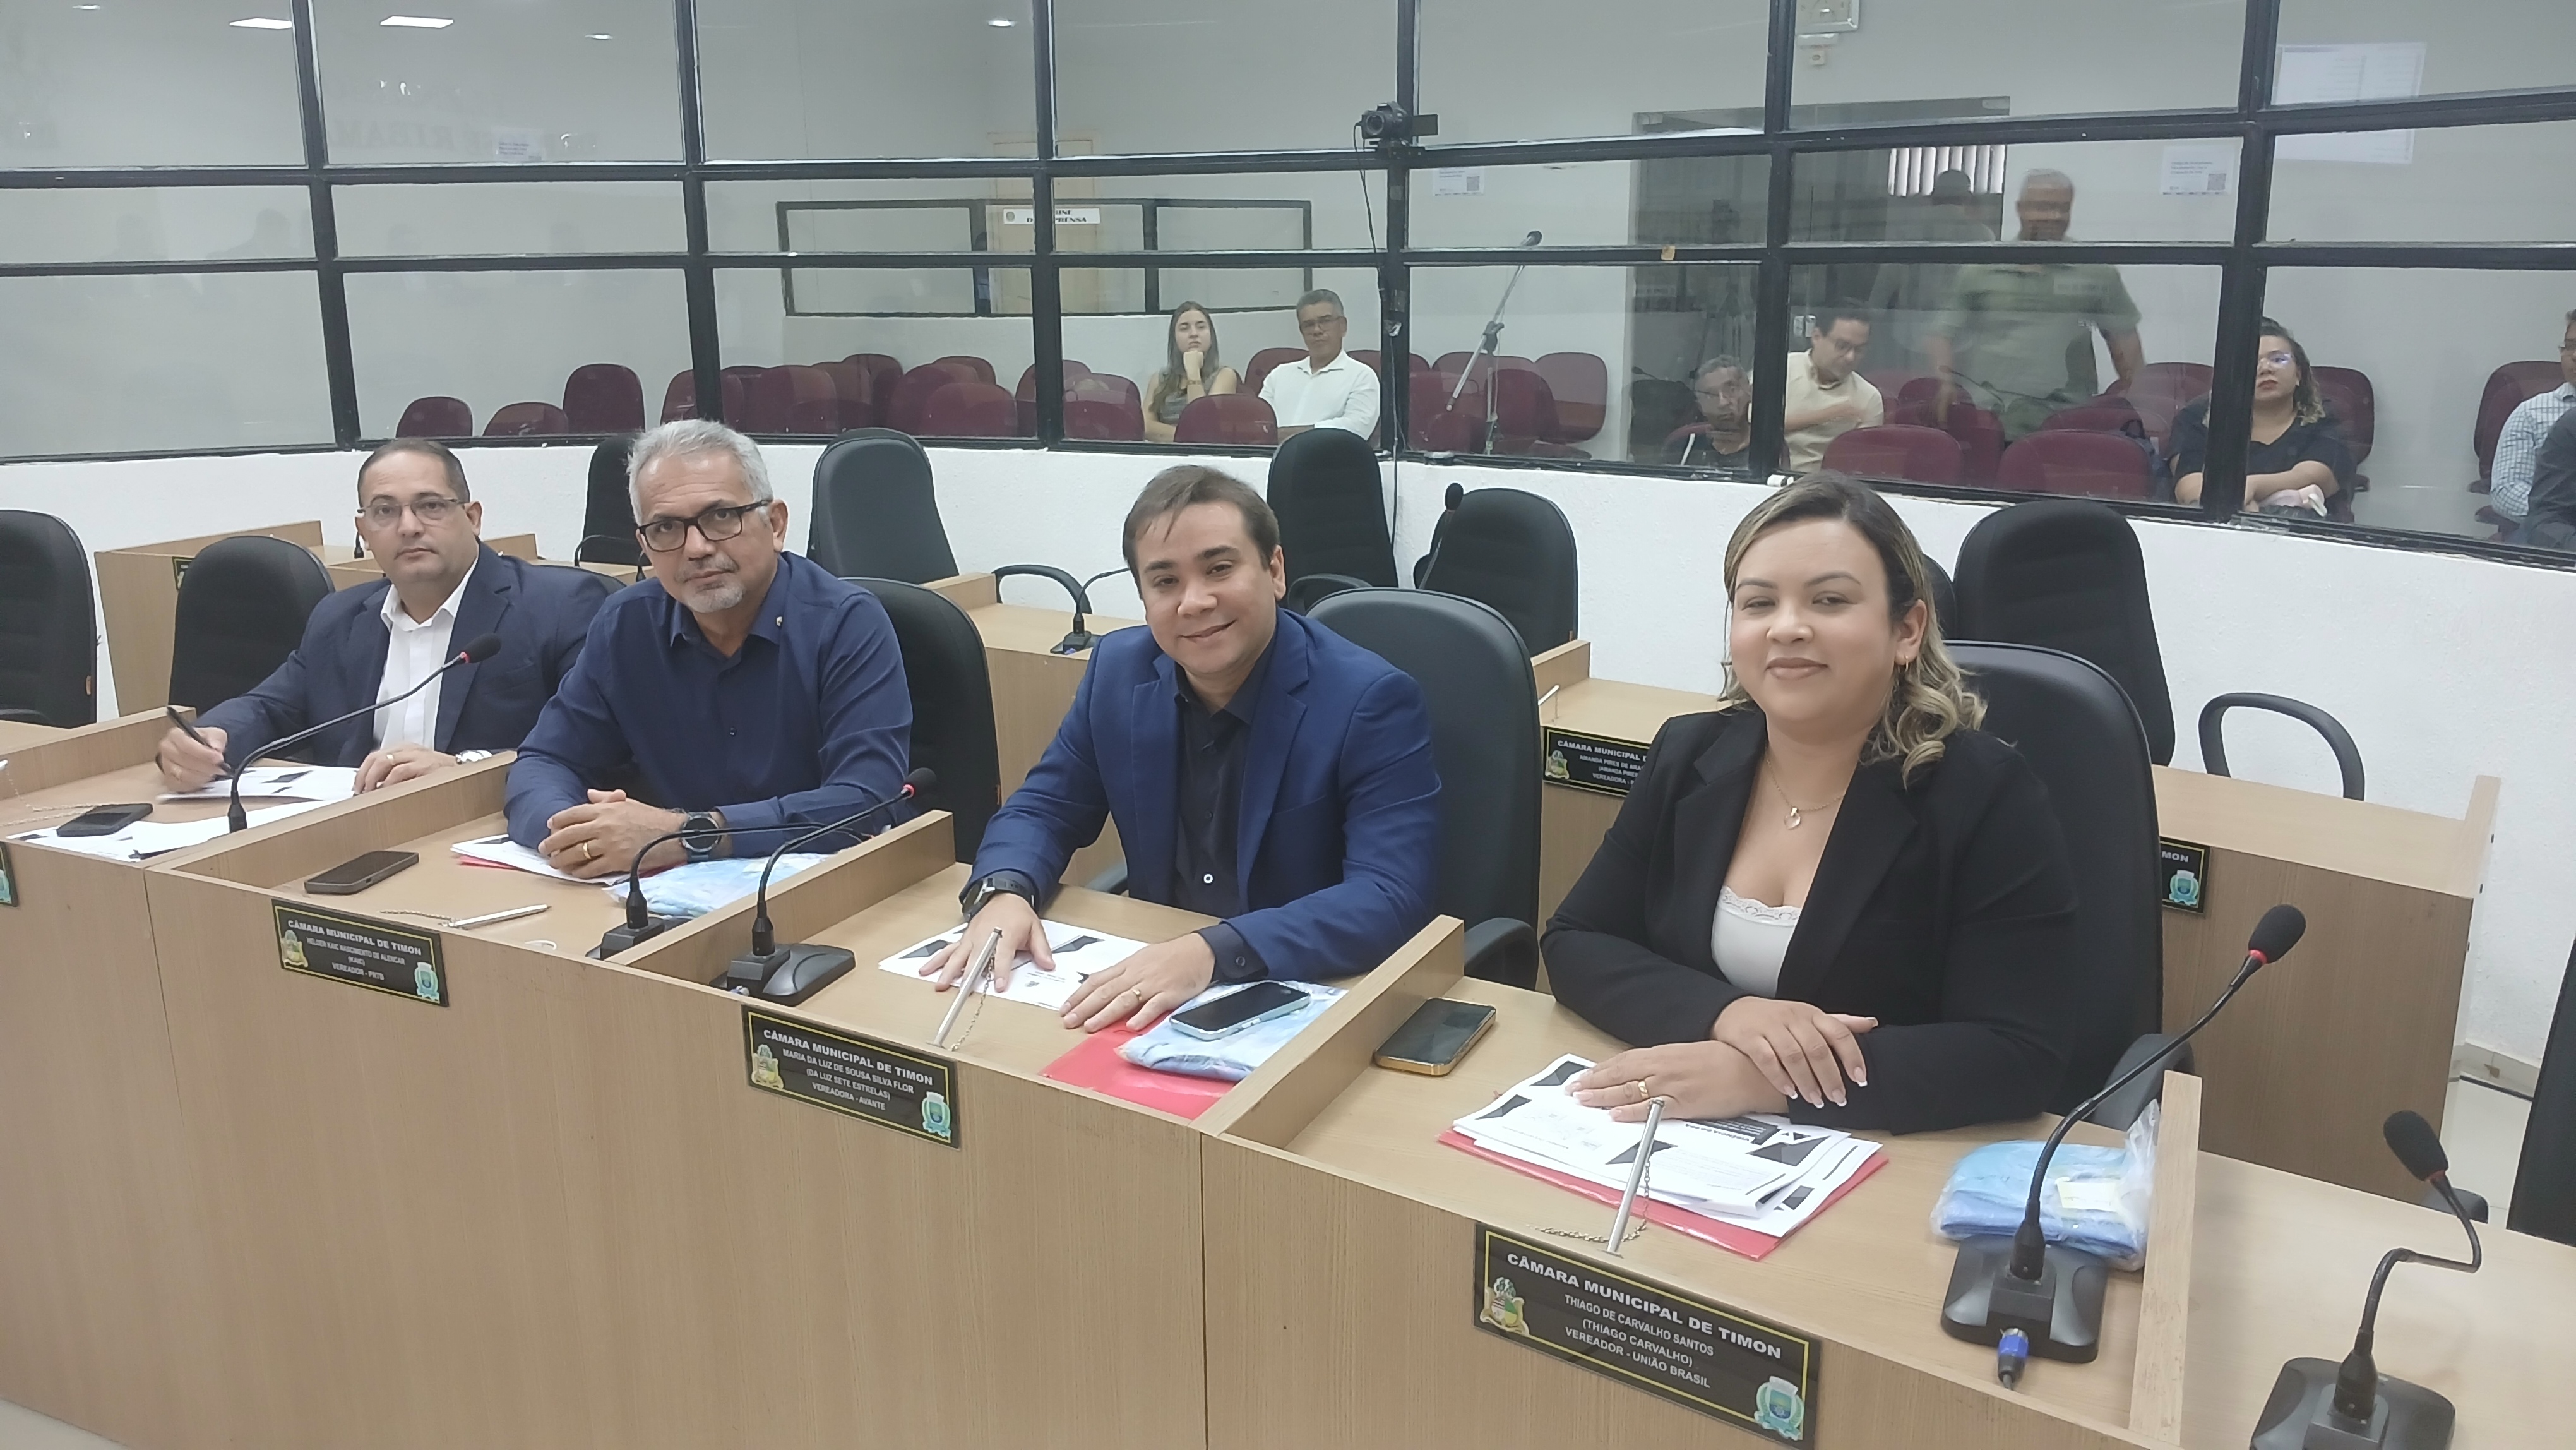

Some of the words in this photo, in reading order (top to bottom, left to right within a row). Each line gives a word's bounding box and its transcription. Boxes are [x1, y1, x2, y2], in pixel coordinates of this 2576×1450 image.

[1557, 740, 1592, 752] CÂMARA
[1594, 746, 1640, 761] MUNICIPAL
[2161, 851, 2189, 863] MON
[287, 920, 325, 935] CÂMARA
[326, 928, 376, 946] MUNICIPAL
[376, 938, 390, 949] DE
[391, 942, 422, 956] TIMON
[331, 962, 364, 976] VEREADOR
[763, 1029, 810, 1050] CÂMARA
[812, 1043, 874, 1069] MUNICIPAL
[876, 1061, 892, 1074] DE
[894, 1066, 933, 1086] TIMON
[782, 1048, 806, 1062] MARIA
[806, 1055, 818, 1065] DA
[818, 1058, 833, 1070] LUZ
[833, 1063, 844, 1073] DE
[845, 1066, 871, 1081] SOUSA
[872, 1074, 893, 1088] SILVA
[893, 1081, 914, 1094] FLOR
[806, 1068, 819, 1078] (DA
[819, 1071, 833, 1082] LUZ
[833, 1076, 852, 1088] SETE
[852, 1081, 891, 1101] ESTRELAS)
[812, 1082, 855, 1101] VEREADORA
[859, 1096, 886, 1111] AVANTE
[1507, 1253, 1580, 1288] CÂMARA
[1584, 1279, 1683, 1324] MUNICIPAL
[1688, 1316, 1713, 1335] DE
[1718, 1326, 1781, 1359] TIMON
[1565, 1293, 1601, 1315] THIAGO
[1602, 1308, 1616, 1321] DE
[1618, 1314, 1671, 1341] CARVALHO
[1673, 1333, 1714, 1357] SANTOS
[1565, 1326, 1624, 1356] VEREADOR
[1632, 1351, 1667, 1372] UNIÃO
[1669, 1365, 1711, 1389] BRASIL
[1582, 1318, 1627, 1341] (THIAGO
[1629, 1335, 1693, 1368] CARVALHO)
